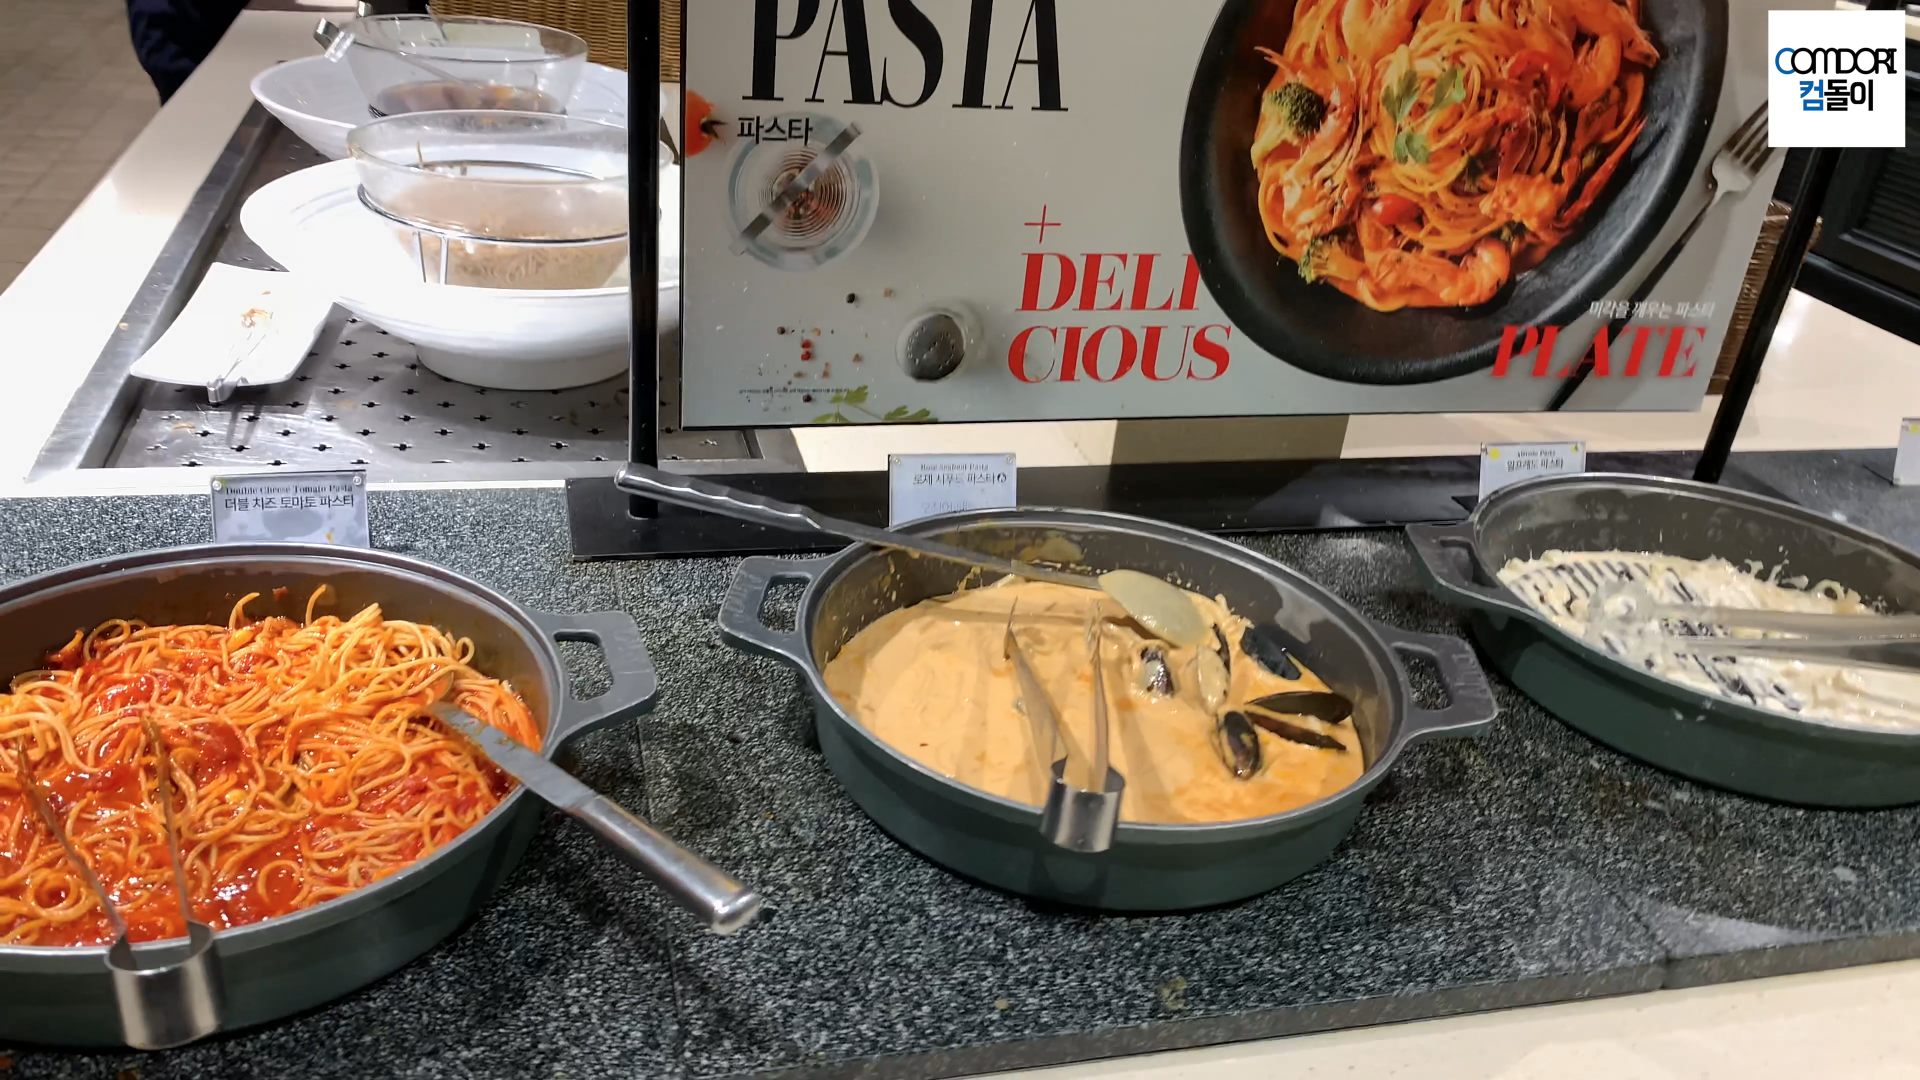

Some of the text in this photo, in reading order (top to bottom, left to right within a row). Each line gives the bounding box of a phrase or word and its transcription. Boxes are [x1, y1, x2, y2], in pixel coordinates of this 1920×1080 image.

[742, 0, 1069, 112] PASTA
[737, 116, 814, 145] 파스타
[1015, 252, 1200, 312] DELI
[1632, 301, 1672, 319] 깨우는
[1675, 301, 1716, 319] 파스타
[1007, 324, 1231, 384] CIOUS
[1490, 324, 1707, 378] PLATE
[1540, 458, 1564, 469] 파스타
[226, 484, 353, 496] Double Cheese Tomato Pasta
[912, 472, 995, 486] 로제 시푸드 파스타
[225, 495, 354, 512] 더블 치즈 토마토 파스타
